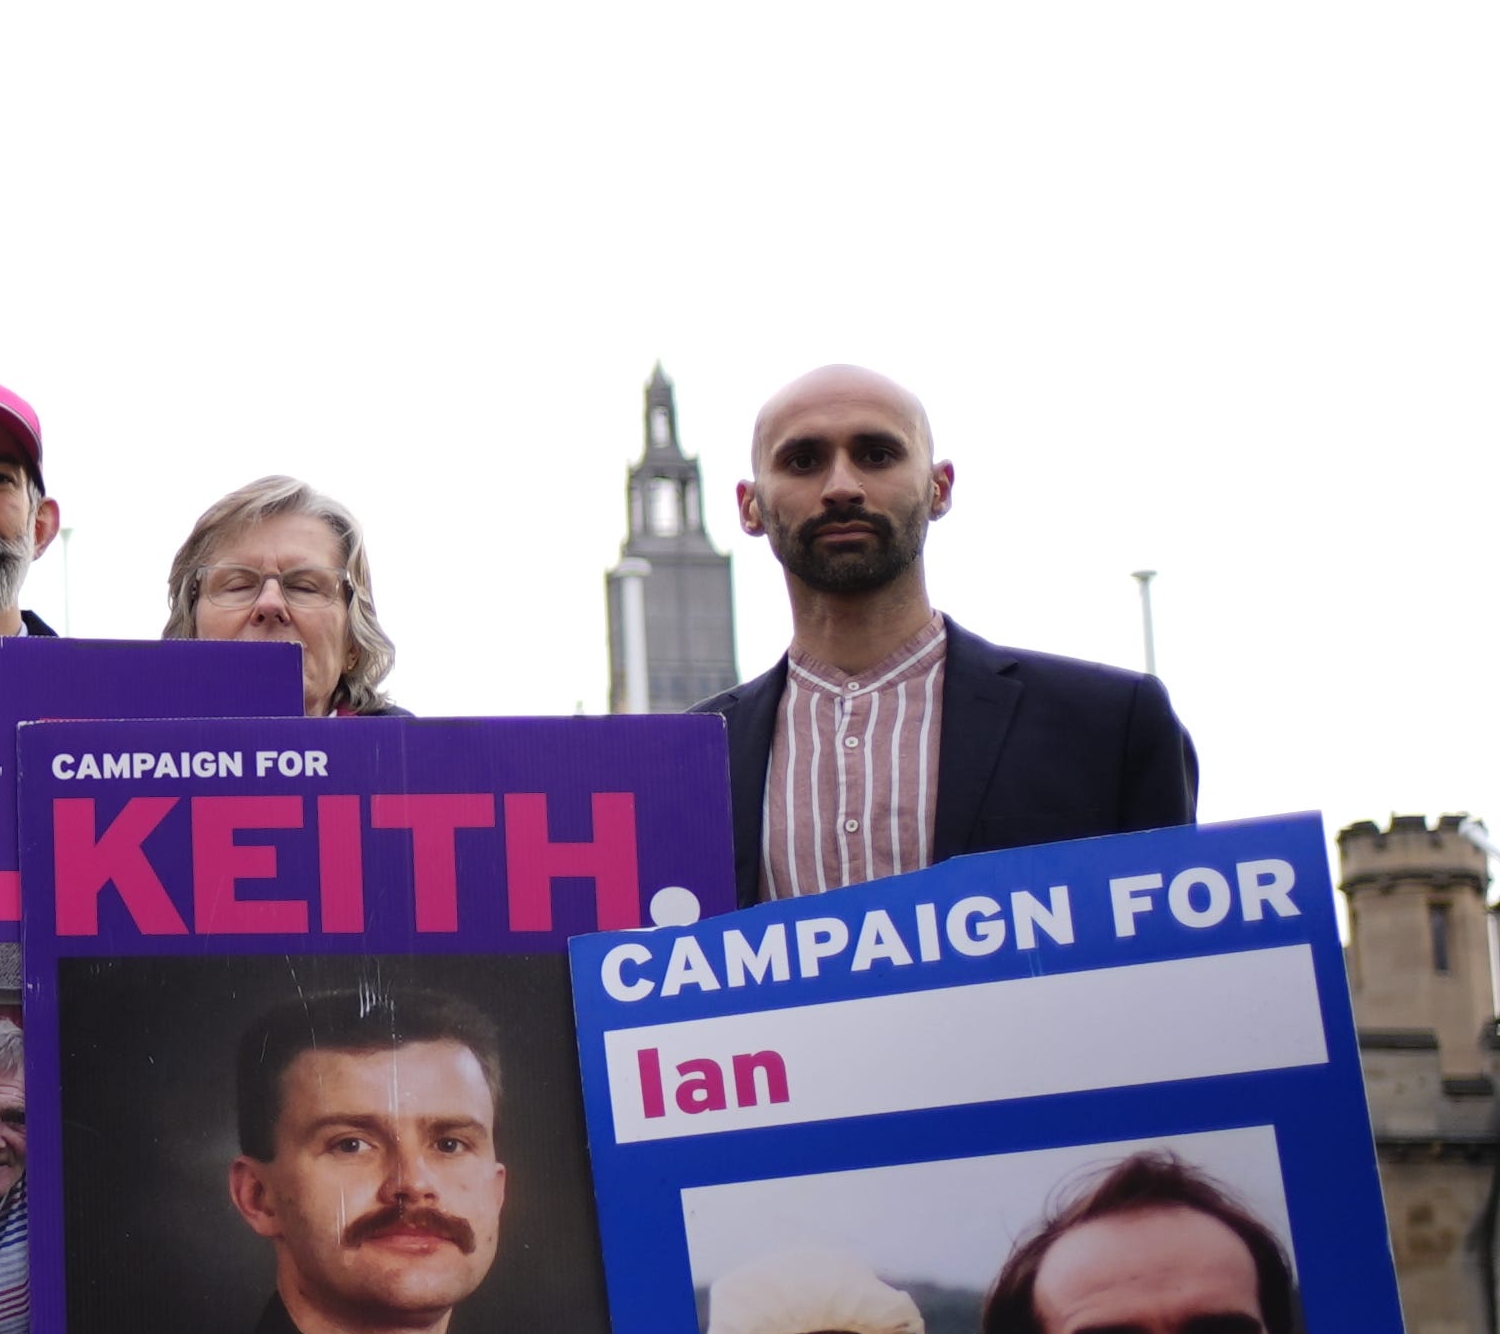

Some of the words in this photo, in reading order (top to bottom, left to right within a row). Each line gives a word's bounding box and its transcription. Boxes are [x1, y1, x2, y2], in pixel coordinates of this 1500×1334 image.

[52, 752, 242, 779] CAMPAIGN
[257, 751, 327, 776] FOR
[52, 791, 700, 935] KEITH.
[602, 886, 1074, 1001] CAMPAIGN
[1110, 859, 1300, 937] FOR
[638, 1049, 791, 1120] Ian
